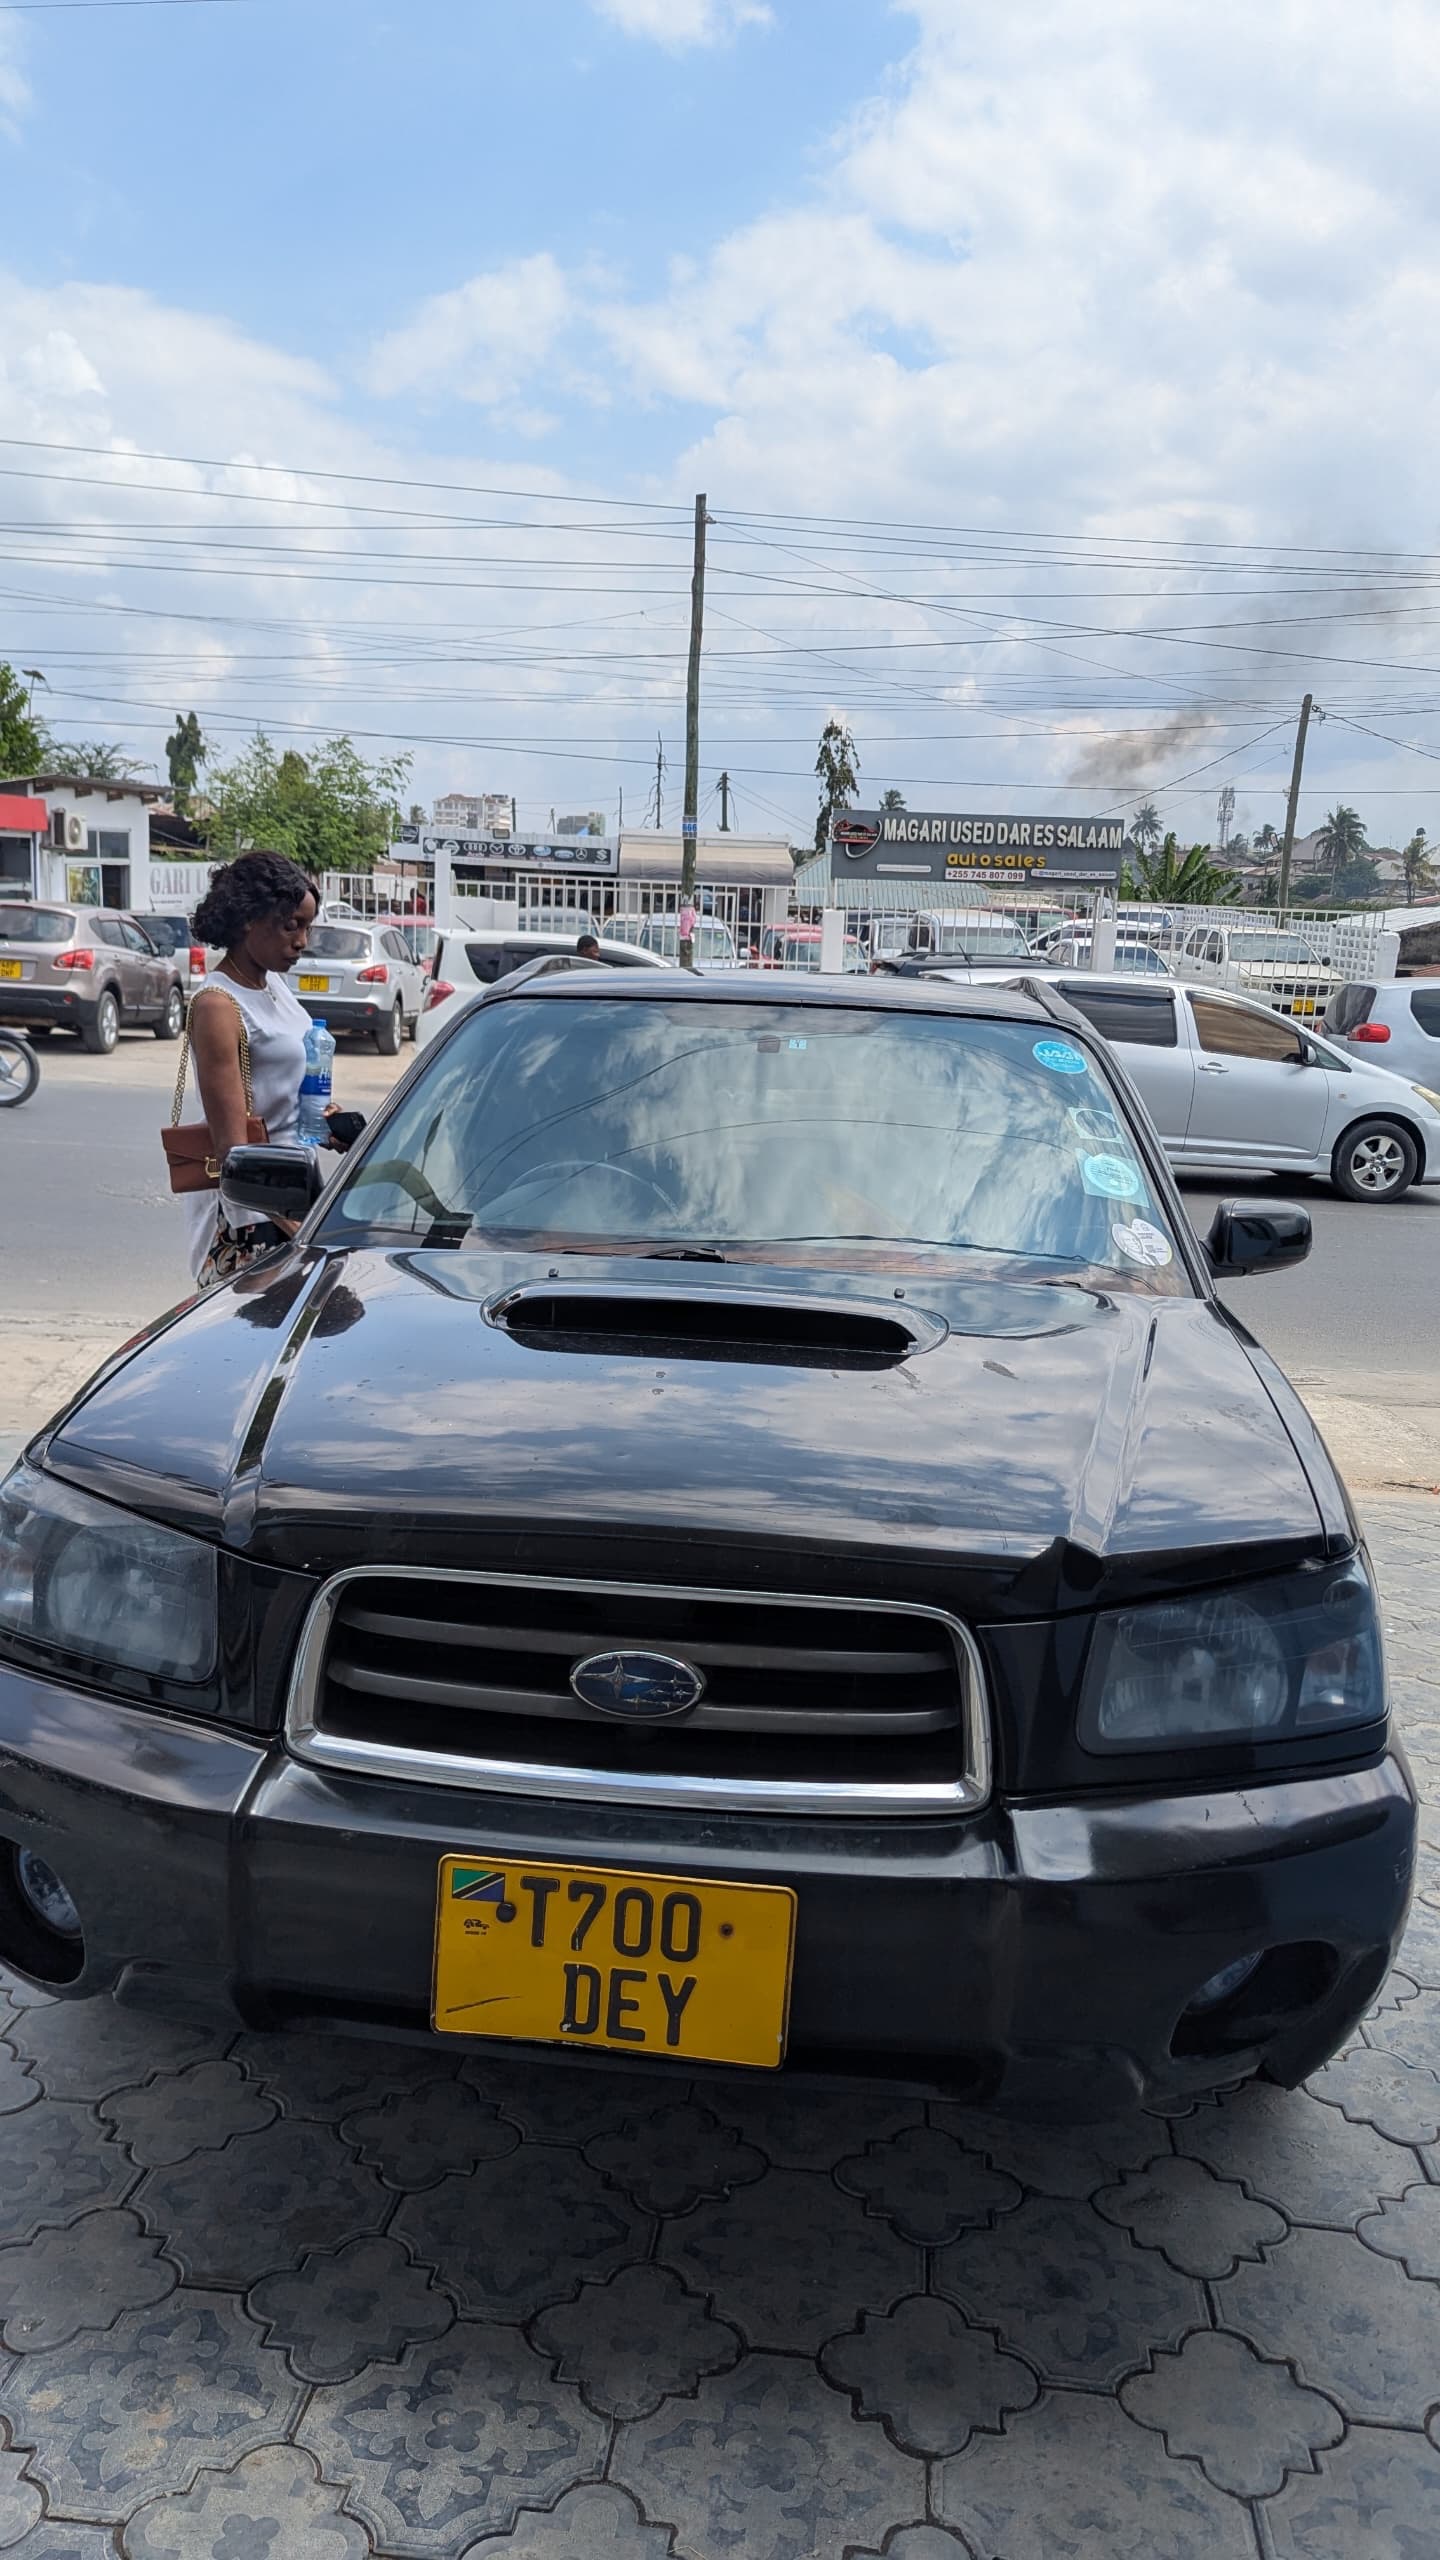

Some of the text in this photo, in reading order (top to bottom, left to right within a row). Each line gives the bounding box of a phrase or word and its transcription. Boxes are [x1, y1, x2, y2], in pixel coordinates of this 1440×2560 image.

[883, 817, 946, 843] MAGARI
[951, 820, 994, 845] USED
[1000, 822, 1030, 846] DAR
[1033, 824, 1054, 847] ES
[1056, 825, 1122, 849] SALAAM
[946, 870, 1024, 881] +255 745 807 099
[559, 1963, 698, 2047] DEY
